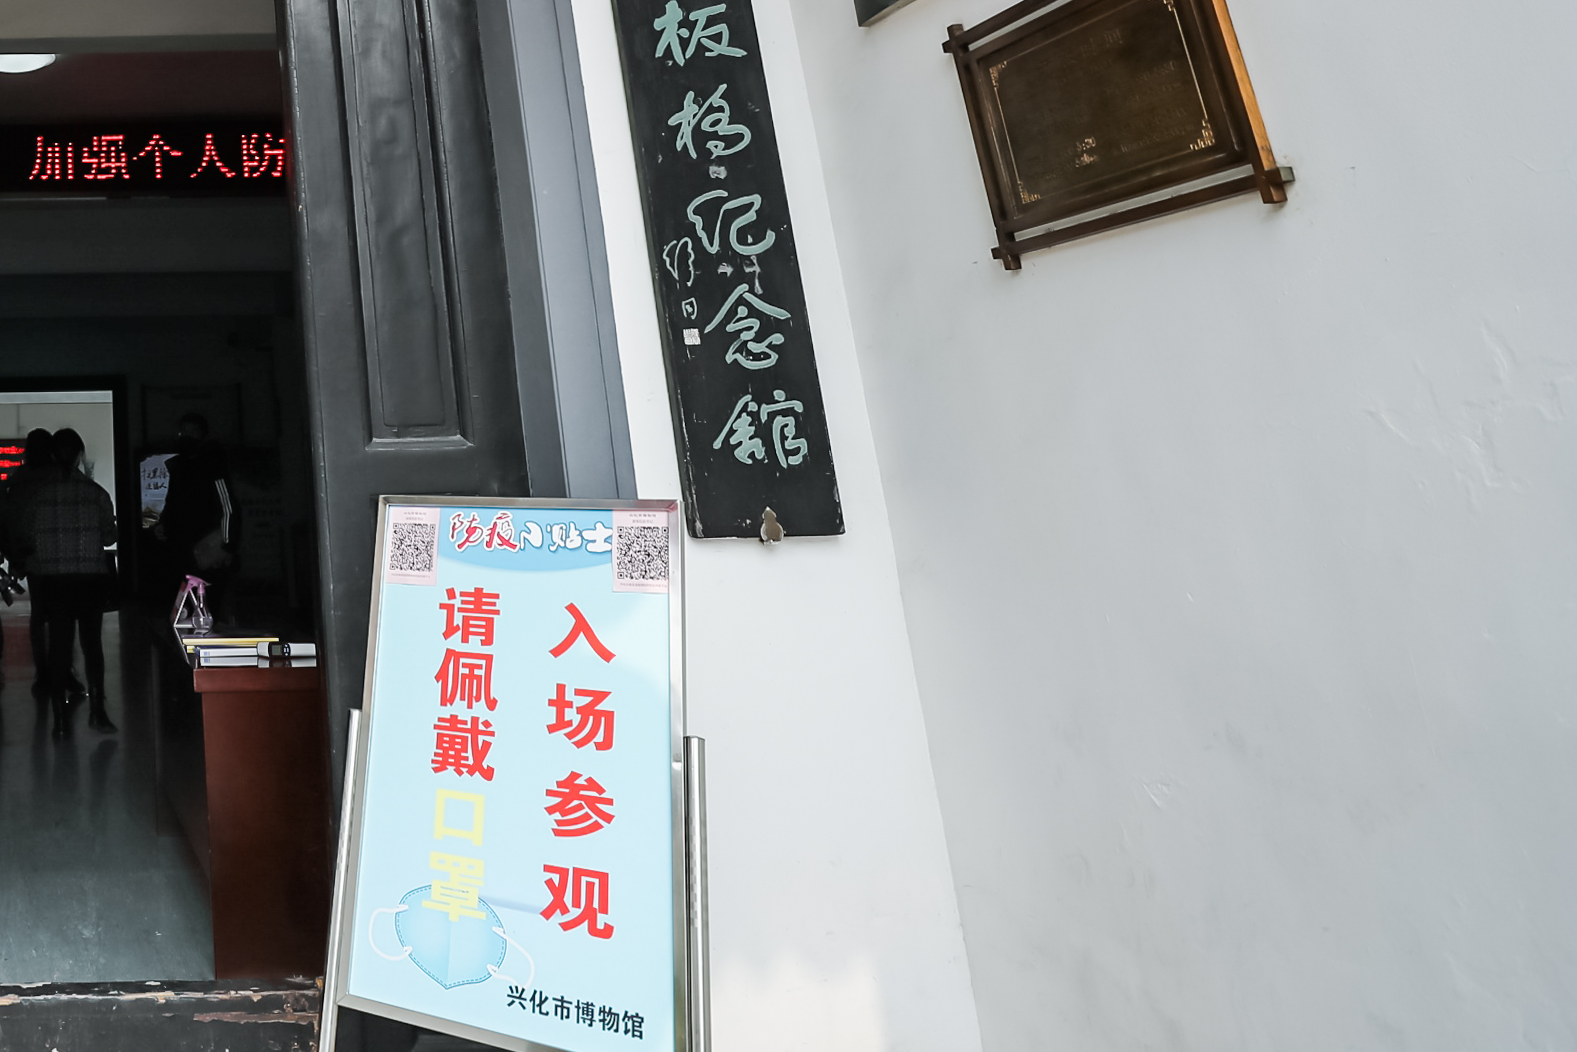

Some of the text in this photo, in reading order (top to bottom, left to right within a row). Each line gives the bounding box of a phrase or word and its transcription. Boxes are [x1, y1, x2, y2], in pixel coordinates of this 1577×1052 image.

[449, 510, 613, 554] 防疫小贴士
[422, 587, 500, 923] 请佩戴口罩
[540, 602, 617, 940] 入场参观
[506, 985, 645, 1040] 兴化市博物馆
